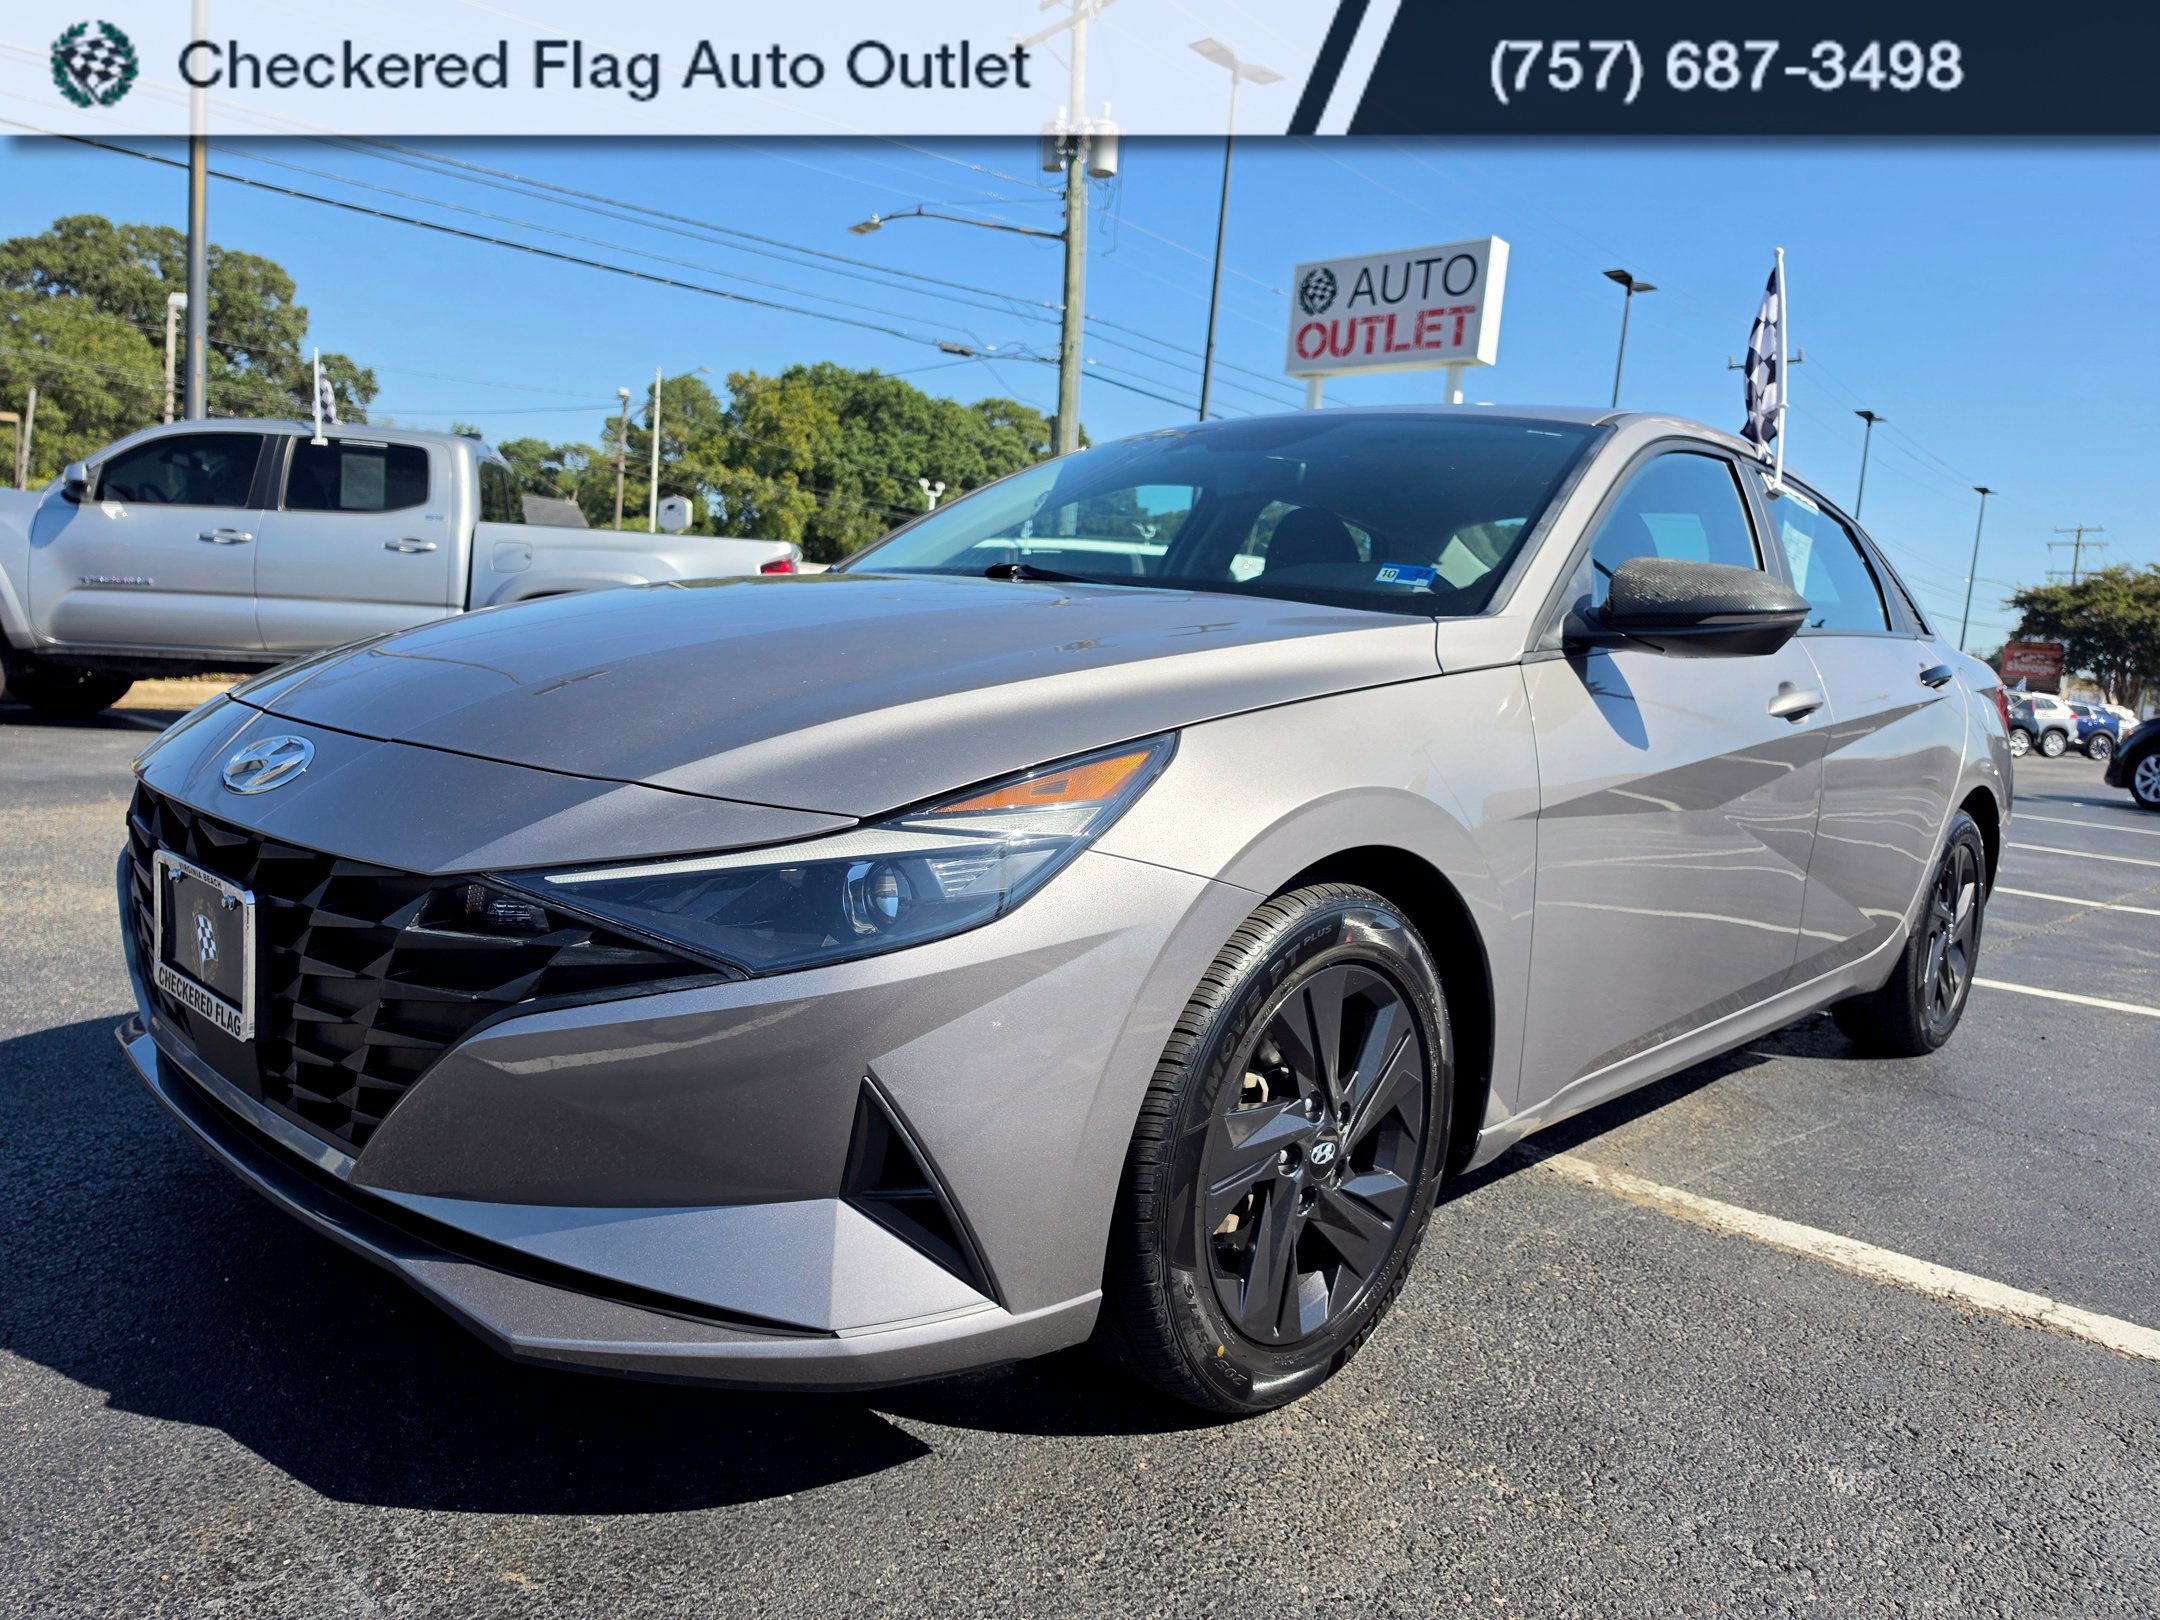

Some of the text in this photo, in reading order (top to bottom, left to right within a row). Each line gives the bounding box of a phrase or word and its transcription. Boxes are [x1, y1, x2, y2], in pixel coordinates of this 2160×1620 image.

[1347, 253, 1478, 309] AUTO
[1295, 305, 1477, 360] OUTLET
[1382, 569, 1397, 578] 10
[202, 872, 222, 889] BEACH
[1269, 941, 1301, 986] PT
[1303, 924, 1333, 947] PLUS
[158, 966, 241, 1036] CHECKERED FLAG
